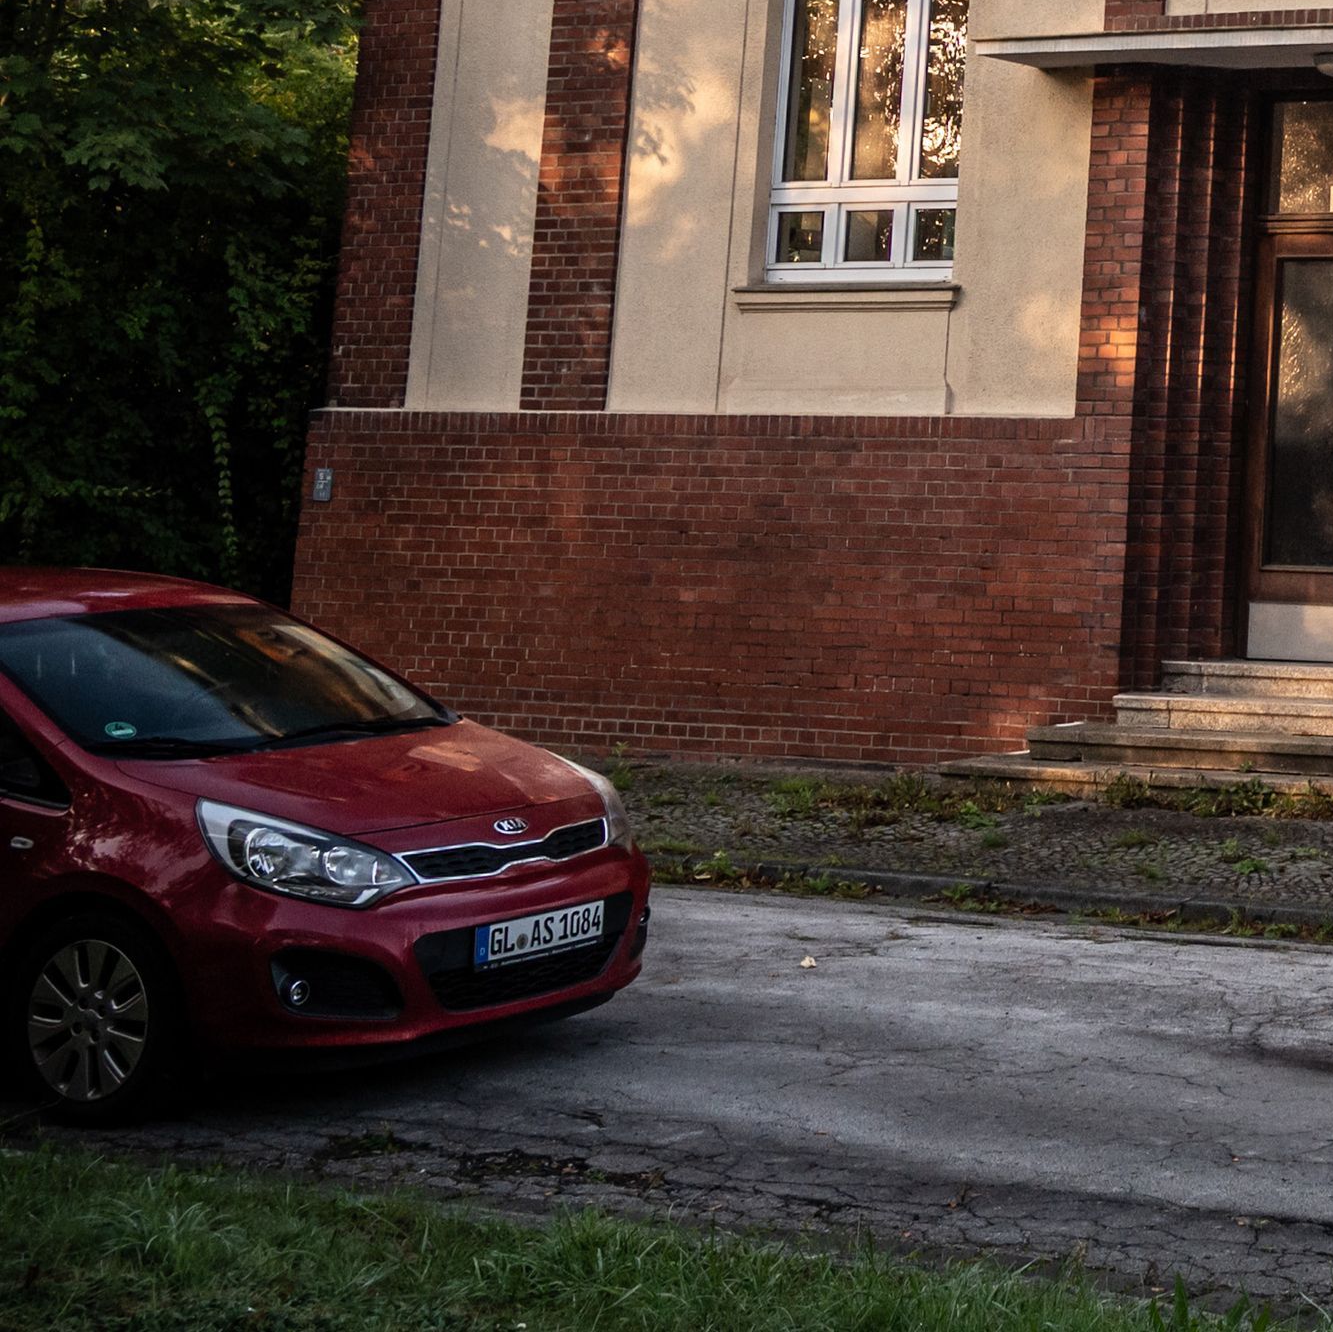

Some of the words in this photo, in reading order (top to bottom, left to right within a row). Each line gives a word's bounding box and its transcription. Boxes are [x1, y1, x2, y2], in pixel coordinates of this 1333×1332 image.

[499, 818, 527, 831] KIA
[489, 925, 516, 956] GL
[530, 915, 555, 948] AS
[558, 905, 602, 941] 1084
